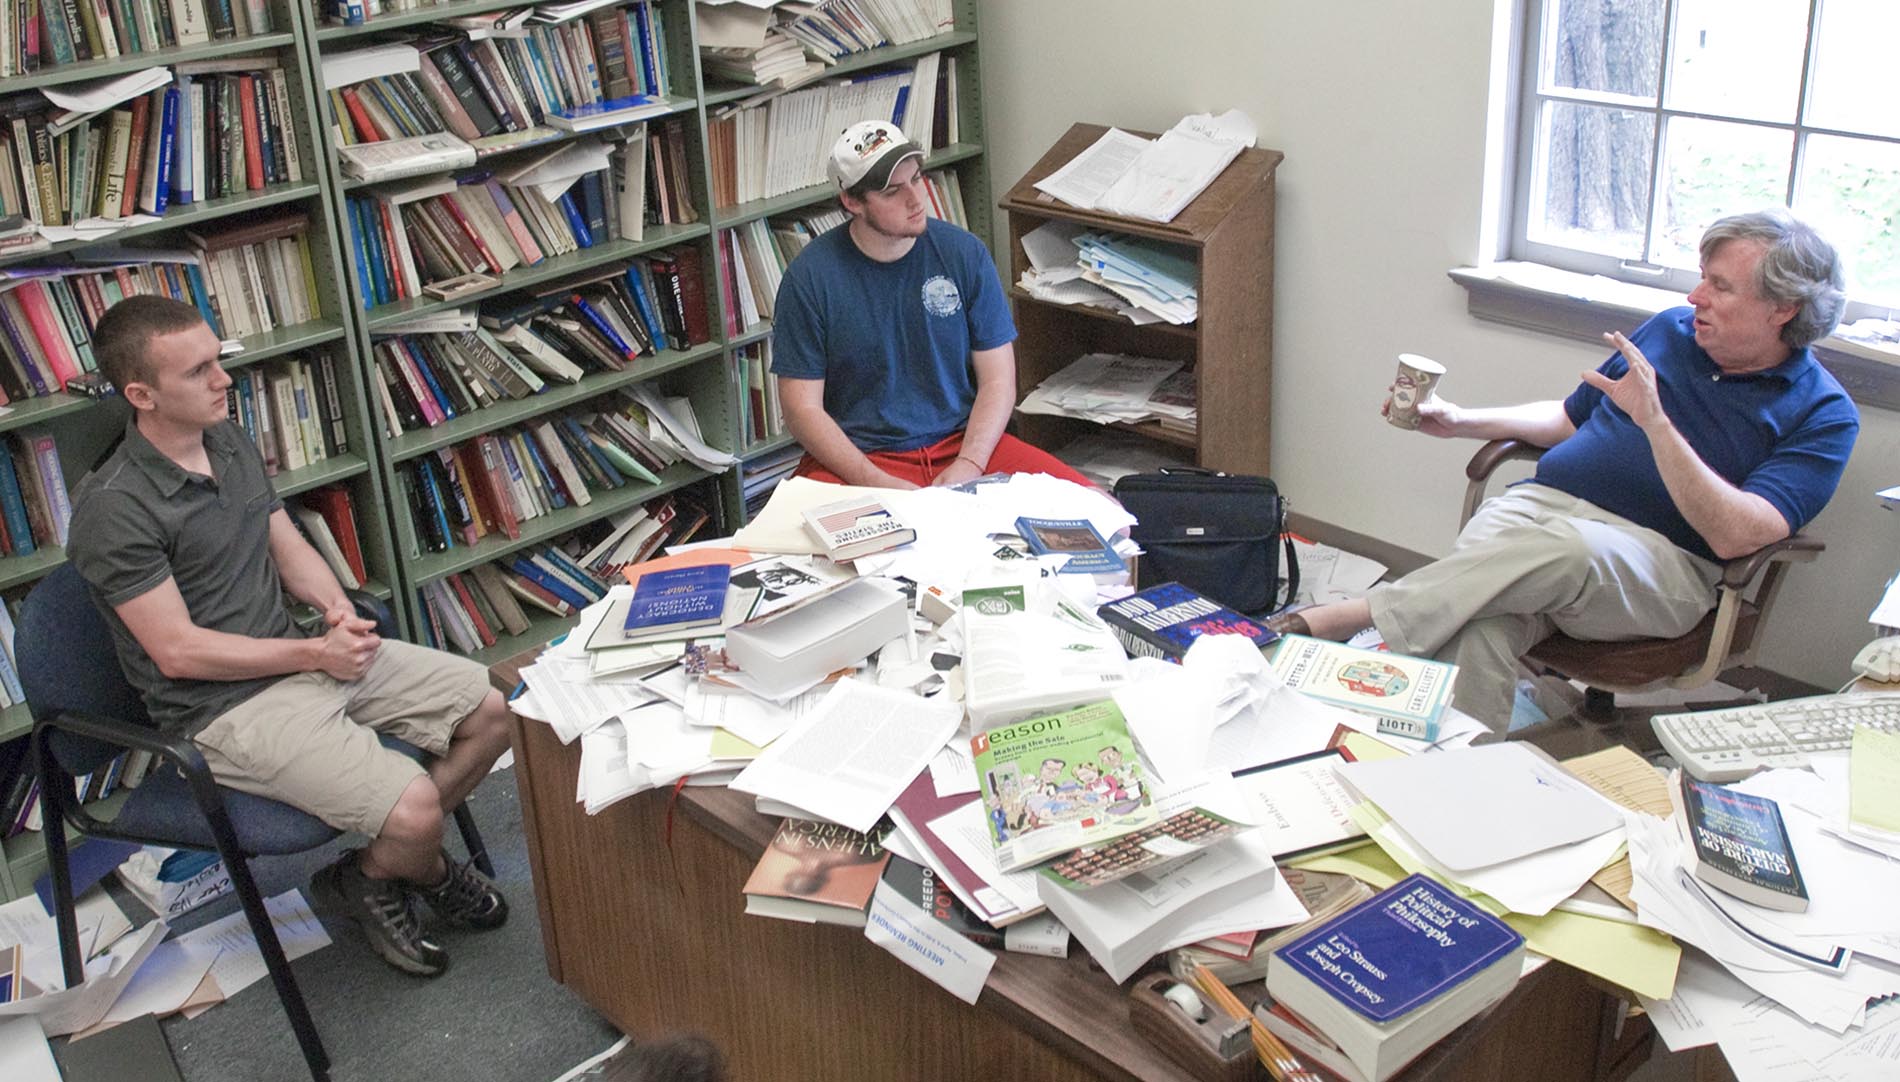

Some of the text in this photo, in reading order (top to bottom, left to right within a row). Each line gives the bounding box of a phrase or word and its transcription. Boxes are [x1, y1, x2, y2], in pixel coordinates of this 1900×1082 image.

[287, 132, 296, 162] RECORD
[35, 128, 58, 222] Politics & Experience
[105, 171, 124, 203] Life
[668, 274, 682, 295] ONE
[470, 346, 497, 372] PLATO
[479, 345, 503, 368] LAWS
[506, 354, 523, 372] state
[835, 526, 873, 538] SIXTIES
[835, 523, 903, 544] REASSESSING
[637, 604, 714, 619] DEMOCRACY
[647, 602, 706, 612] WITHOUT
[1109, 597, 1157, 618] DAVID
[1132, 597, 1222, 632] HALBERSTAM
[1410, 666, 1437, 712] CARL ELLIOTT
[977, 716, 1061, 749] reason
[1379, 717, 1414, 732] LIOTT
[993, 734, 1065, 758] Making the Sale
[776, 831, 883, 856] ALIENS IN
[1697, 827, 1786, 864] NARCISSISM
[1701, 838, 1791, 875] CULTURE OF
[922, 867, 934, 915] FREEDO
[1399, 894, 1453, 930] Political
[1412, 886, 1479, 930] History of
[868, 911, 909, 943] REMINDER
[1388, 900, 1456, 948] Philosophy
[898, 939, 956, 970] MEETING
[1317, 942, 1342, 961] and
[1327, 935, 1389, 982] Leo Strauss
[1306, 948, 1386, 1006] Joseph Cropsey
